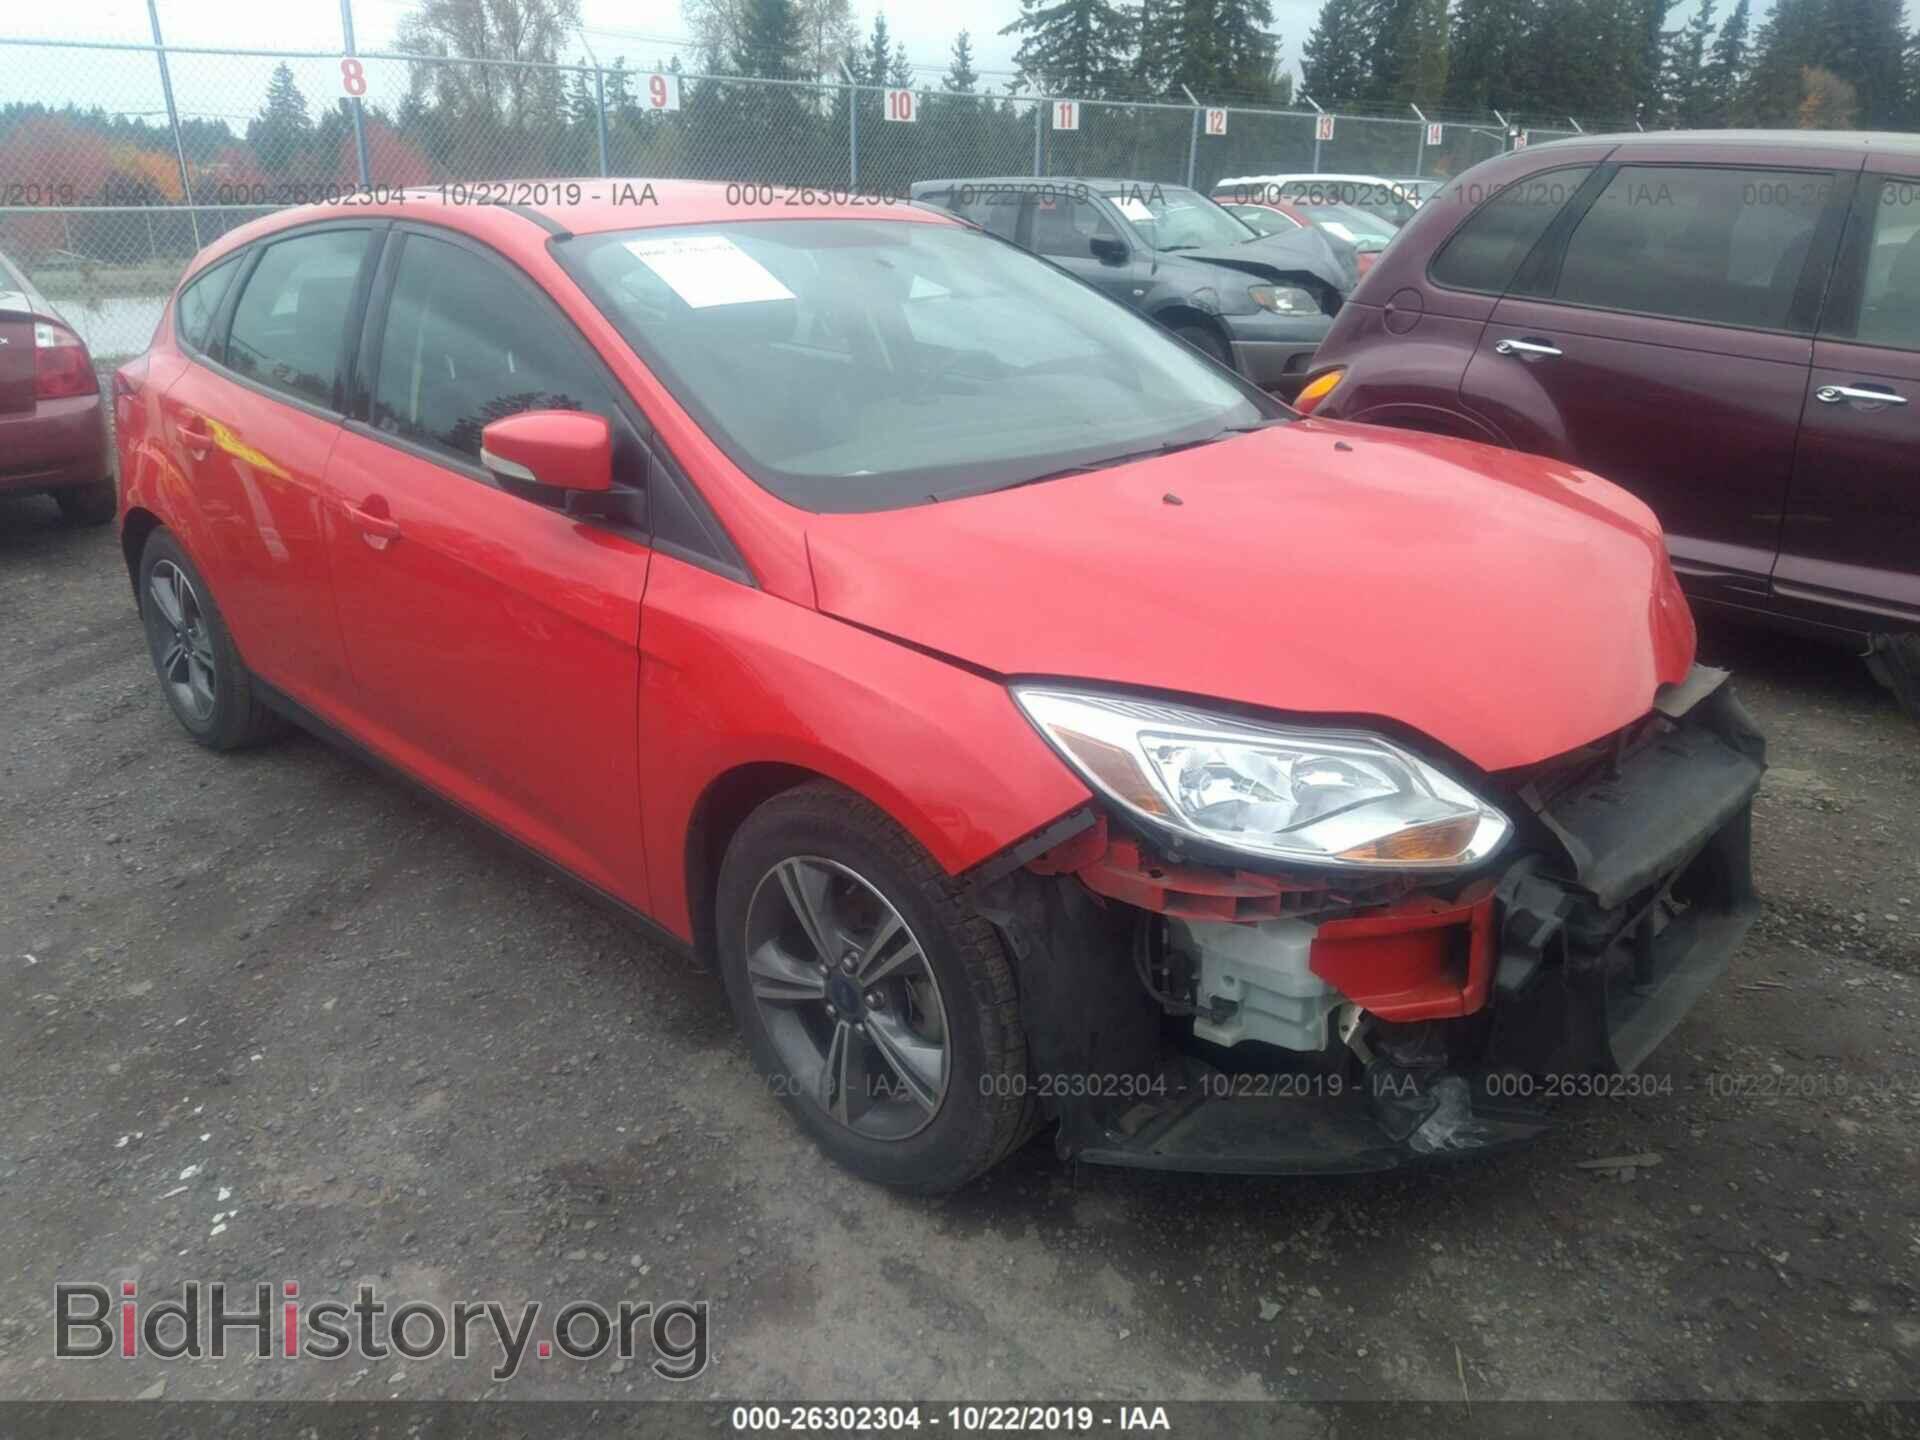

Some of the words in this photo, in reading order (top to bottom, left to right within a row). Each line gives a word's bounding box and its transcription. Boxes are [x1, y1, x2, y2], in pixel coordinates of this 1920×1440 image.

[341, 59, 366, 95] 8
[649, 75, 666, 107] 9
[890, 91, 911, 119] 10
[1060, 103, 1072, 128] 11
[1209, 111, 1222, 132] 12
